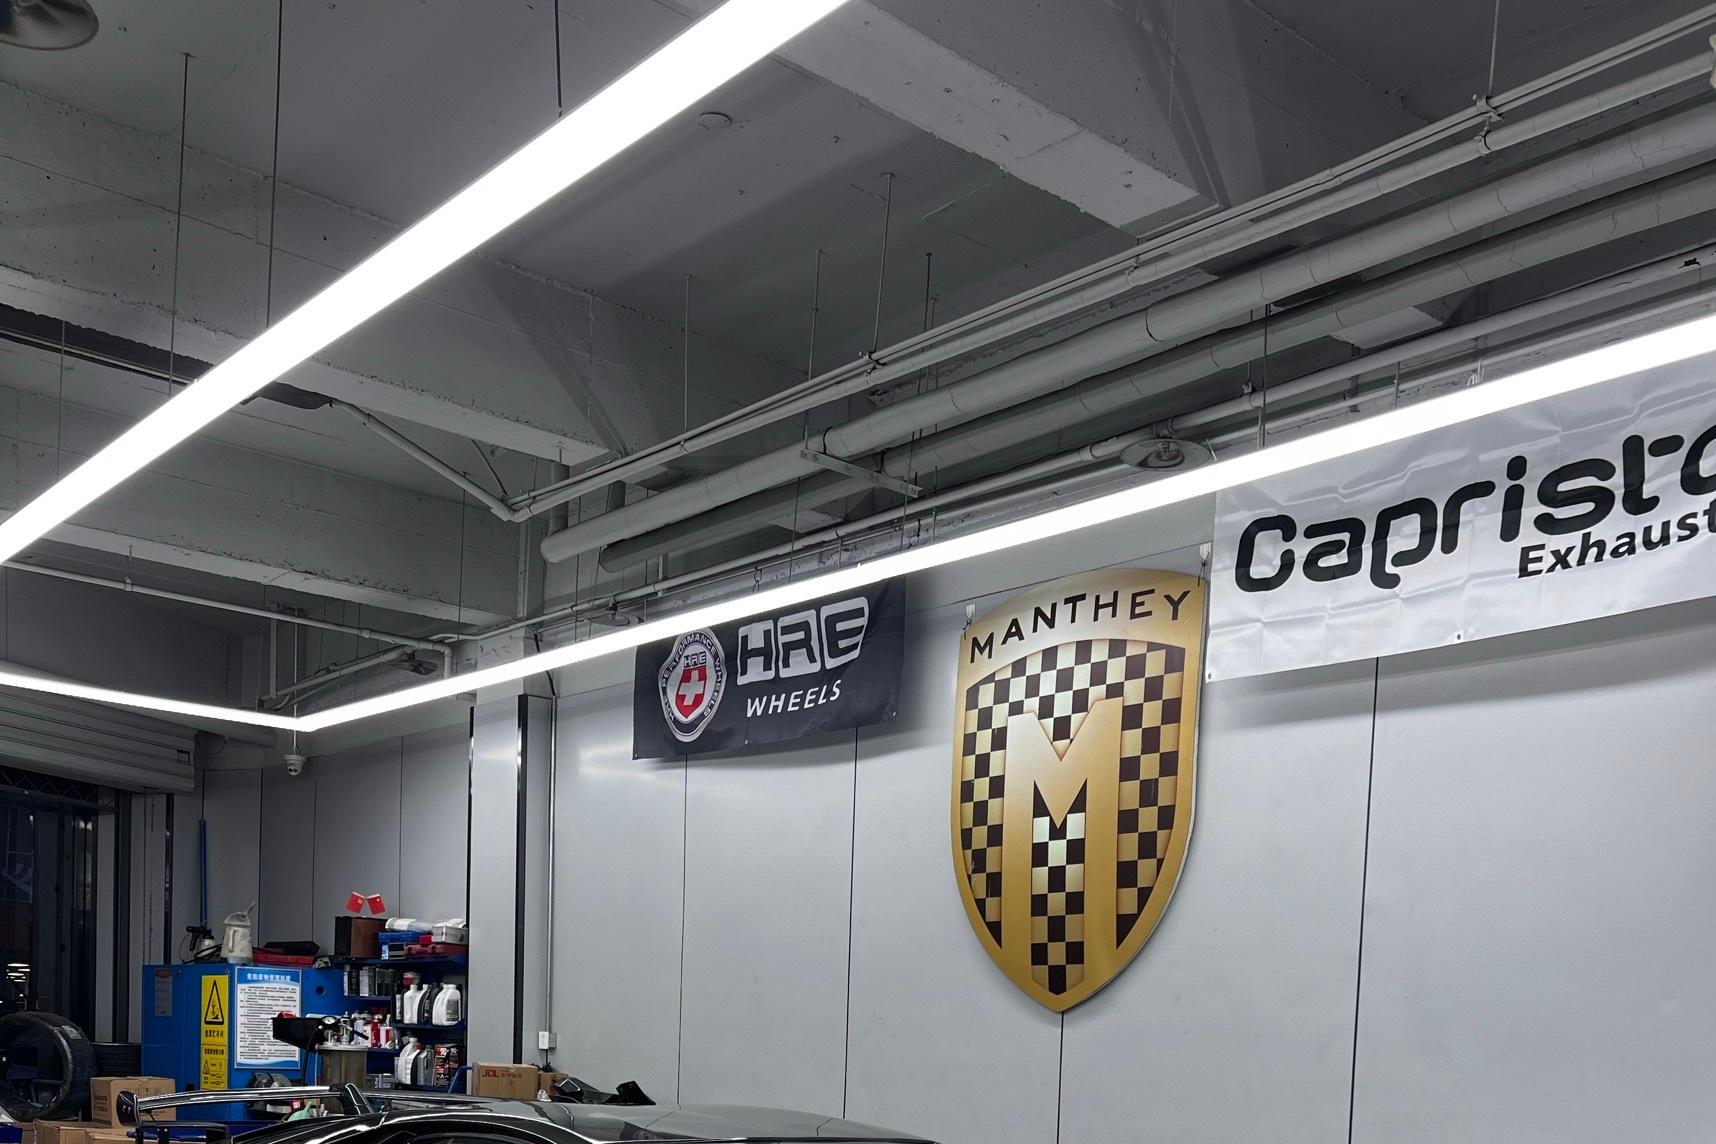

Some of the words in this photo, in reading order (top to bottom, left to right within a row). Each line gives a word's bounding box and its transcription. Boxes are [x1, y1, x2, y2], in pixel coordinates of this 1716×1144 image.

[1518, 498, 1716, 578] Exhaust
[684, 651, 706, 668] HRE
[737, 597, 868, 686] HRE
[970, 589, 1190, 664] MANTHEY
[746, 681, 841, 718] WHEELS
